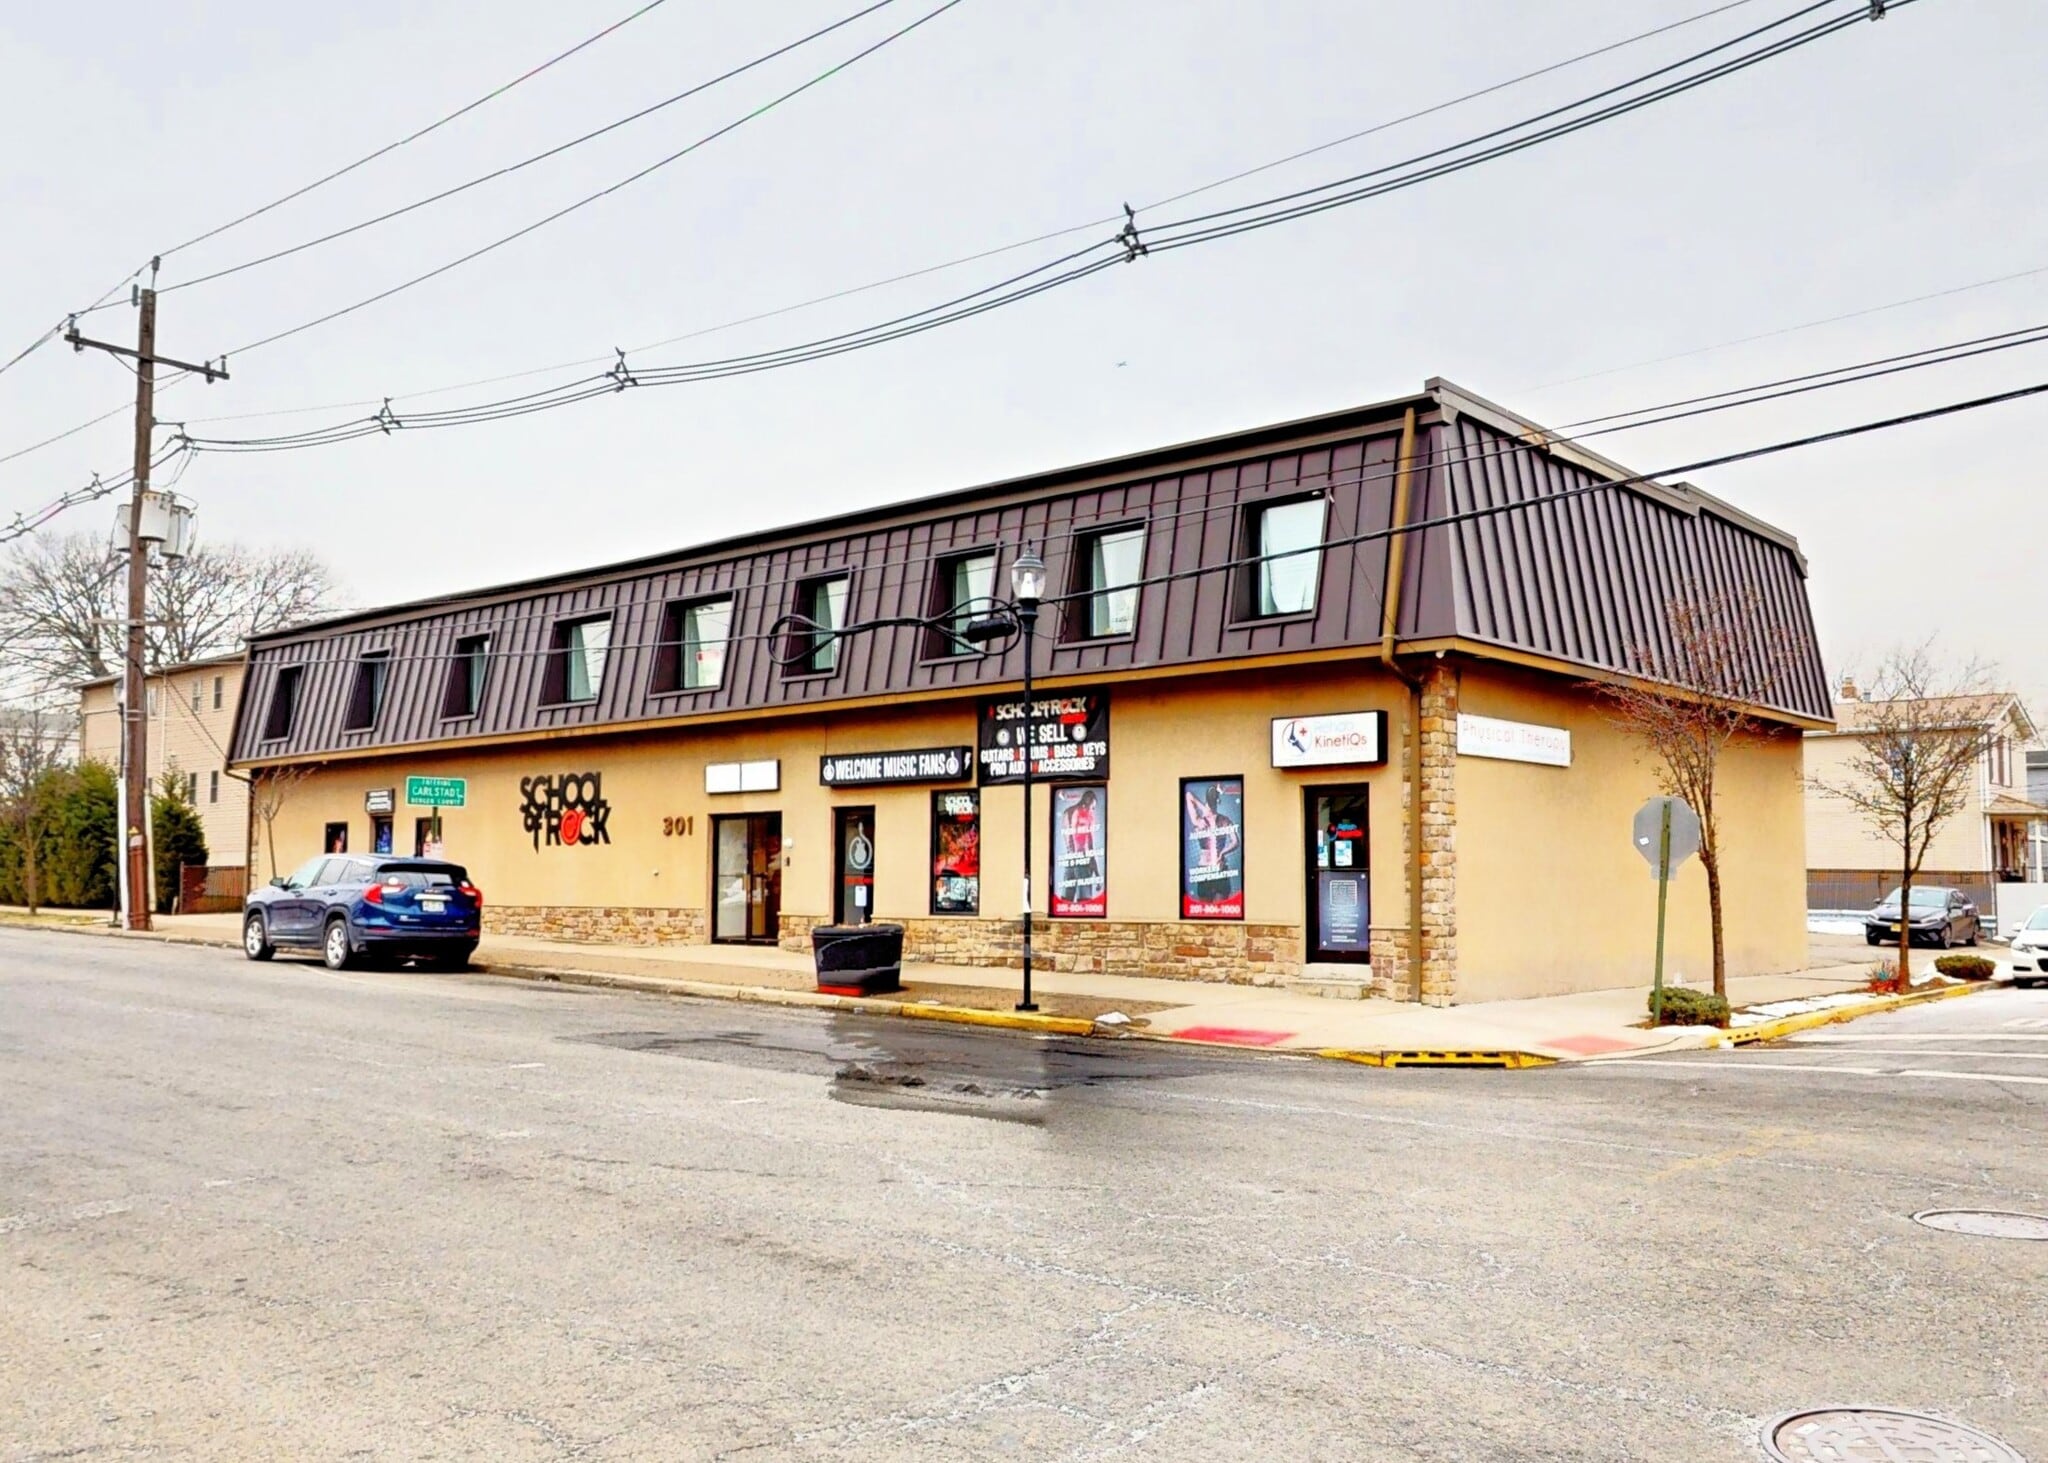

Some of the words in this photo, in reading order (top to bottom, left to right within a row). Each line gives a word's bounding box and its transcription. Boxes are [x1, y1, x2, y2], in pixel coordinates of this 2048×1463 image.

[996, 701, 1041, 720] SCHOL
[1050, 696, 1087, 715] ROCK
[1039, 723, 1068, 743] SELL
[1315, 732, 1368, 748] KinetiQs
[1463, 720, 1515, 744] Physical
[1519, 727, 1566, 752] Therapy
[980, 747, 1014, 764] GUITARS
[1020, 745, 1048, 761] DUMS
[1054, 743, 1077, 758] BASS
[1083, 741, 1106, 756] KEYS
[835, 757, 882, 780] WELCOME
[883, 755, 917, 778] MUSIC
[919, 753, 946, 775] FANS
[990, 762, 1007, 776] PRO
[1009, 760, 1034, 774] AUD
[1038, 757, 1095, 773] ACCESSORIES
[412, 786, 462, 797] CARLSTADT
[520, 772, 608, 809] SCHOOL
[546, 806, 611, 846] ROCK
[663, 816, 694, 836] 301
